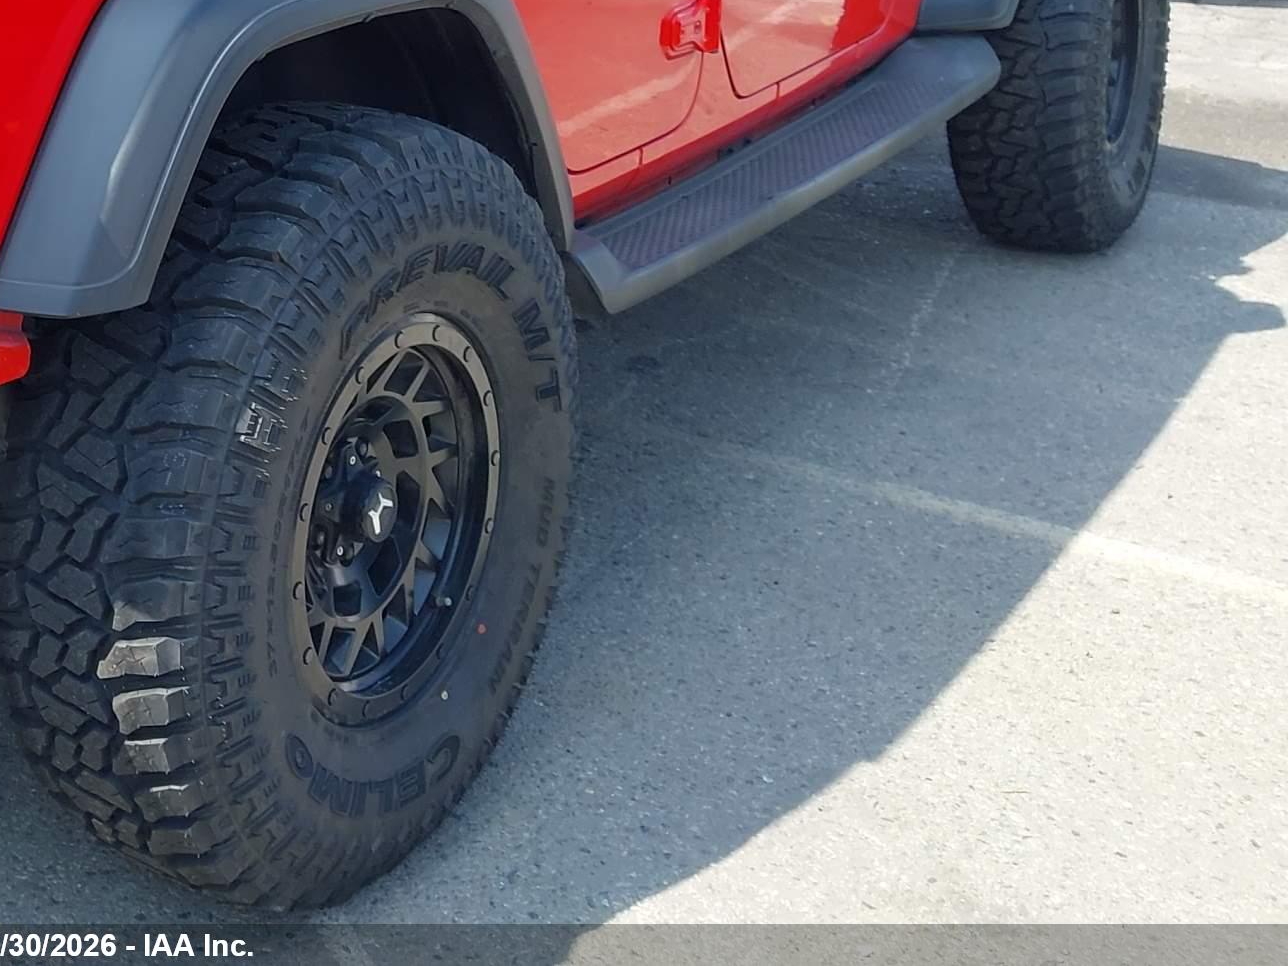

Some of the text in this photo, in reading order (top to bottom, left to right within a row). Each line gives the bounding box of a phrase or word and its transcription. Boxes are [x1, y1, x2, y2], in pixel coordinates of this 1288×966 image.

[339, 241, 563, 414] PREVAIL M/T
[486, 475, 558, 698] MUD TERRAIN
[283, 732, 461, 820] CELIMO
